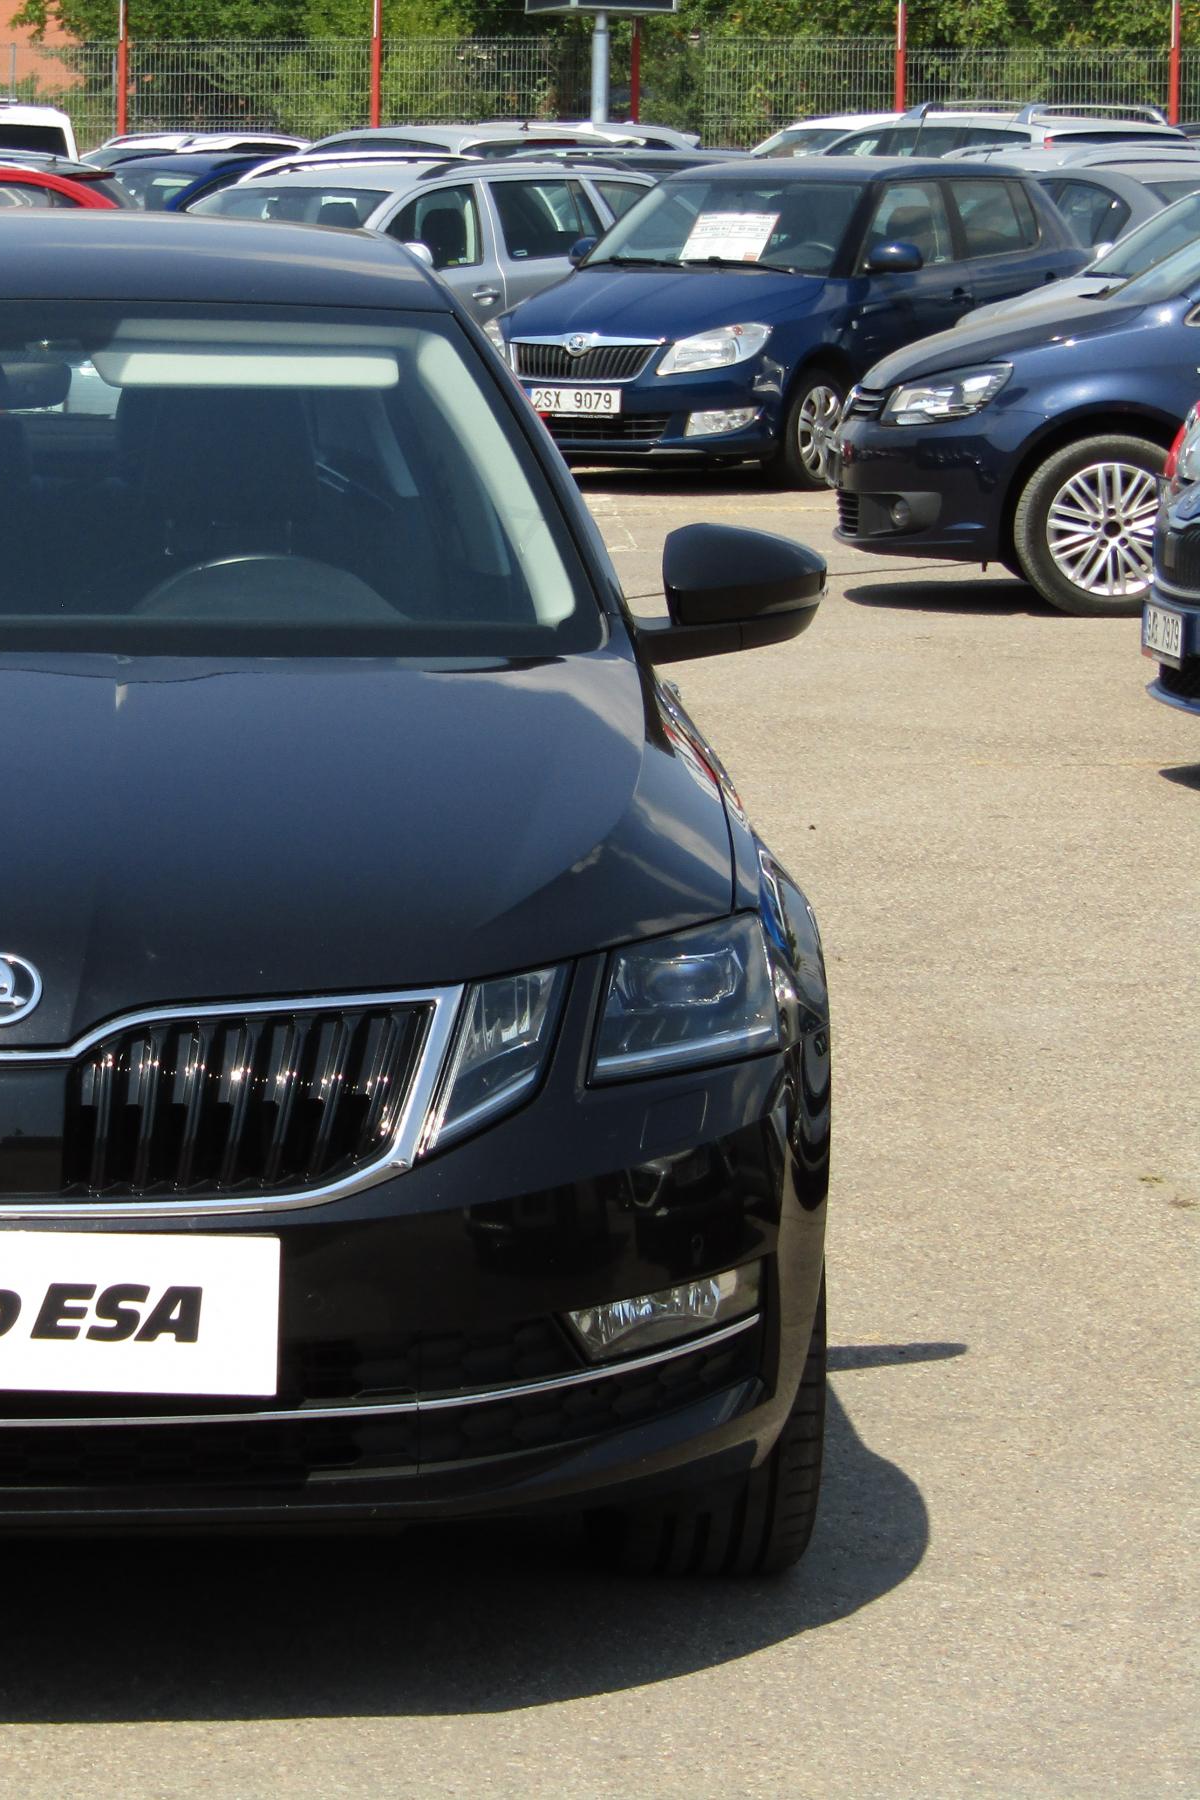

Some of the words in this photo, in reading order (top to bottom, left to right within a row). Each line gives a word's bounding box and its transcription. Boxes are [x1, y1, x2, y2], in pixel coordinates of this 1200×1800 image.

[535, 390, 561, 409] 2SX
[574, 391, 612, 410] 9079
[30, 1283, 203, 1343] ESA
